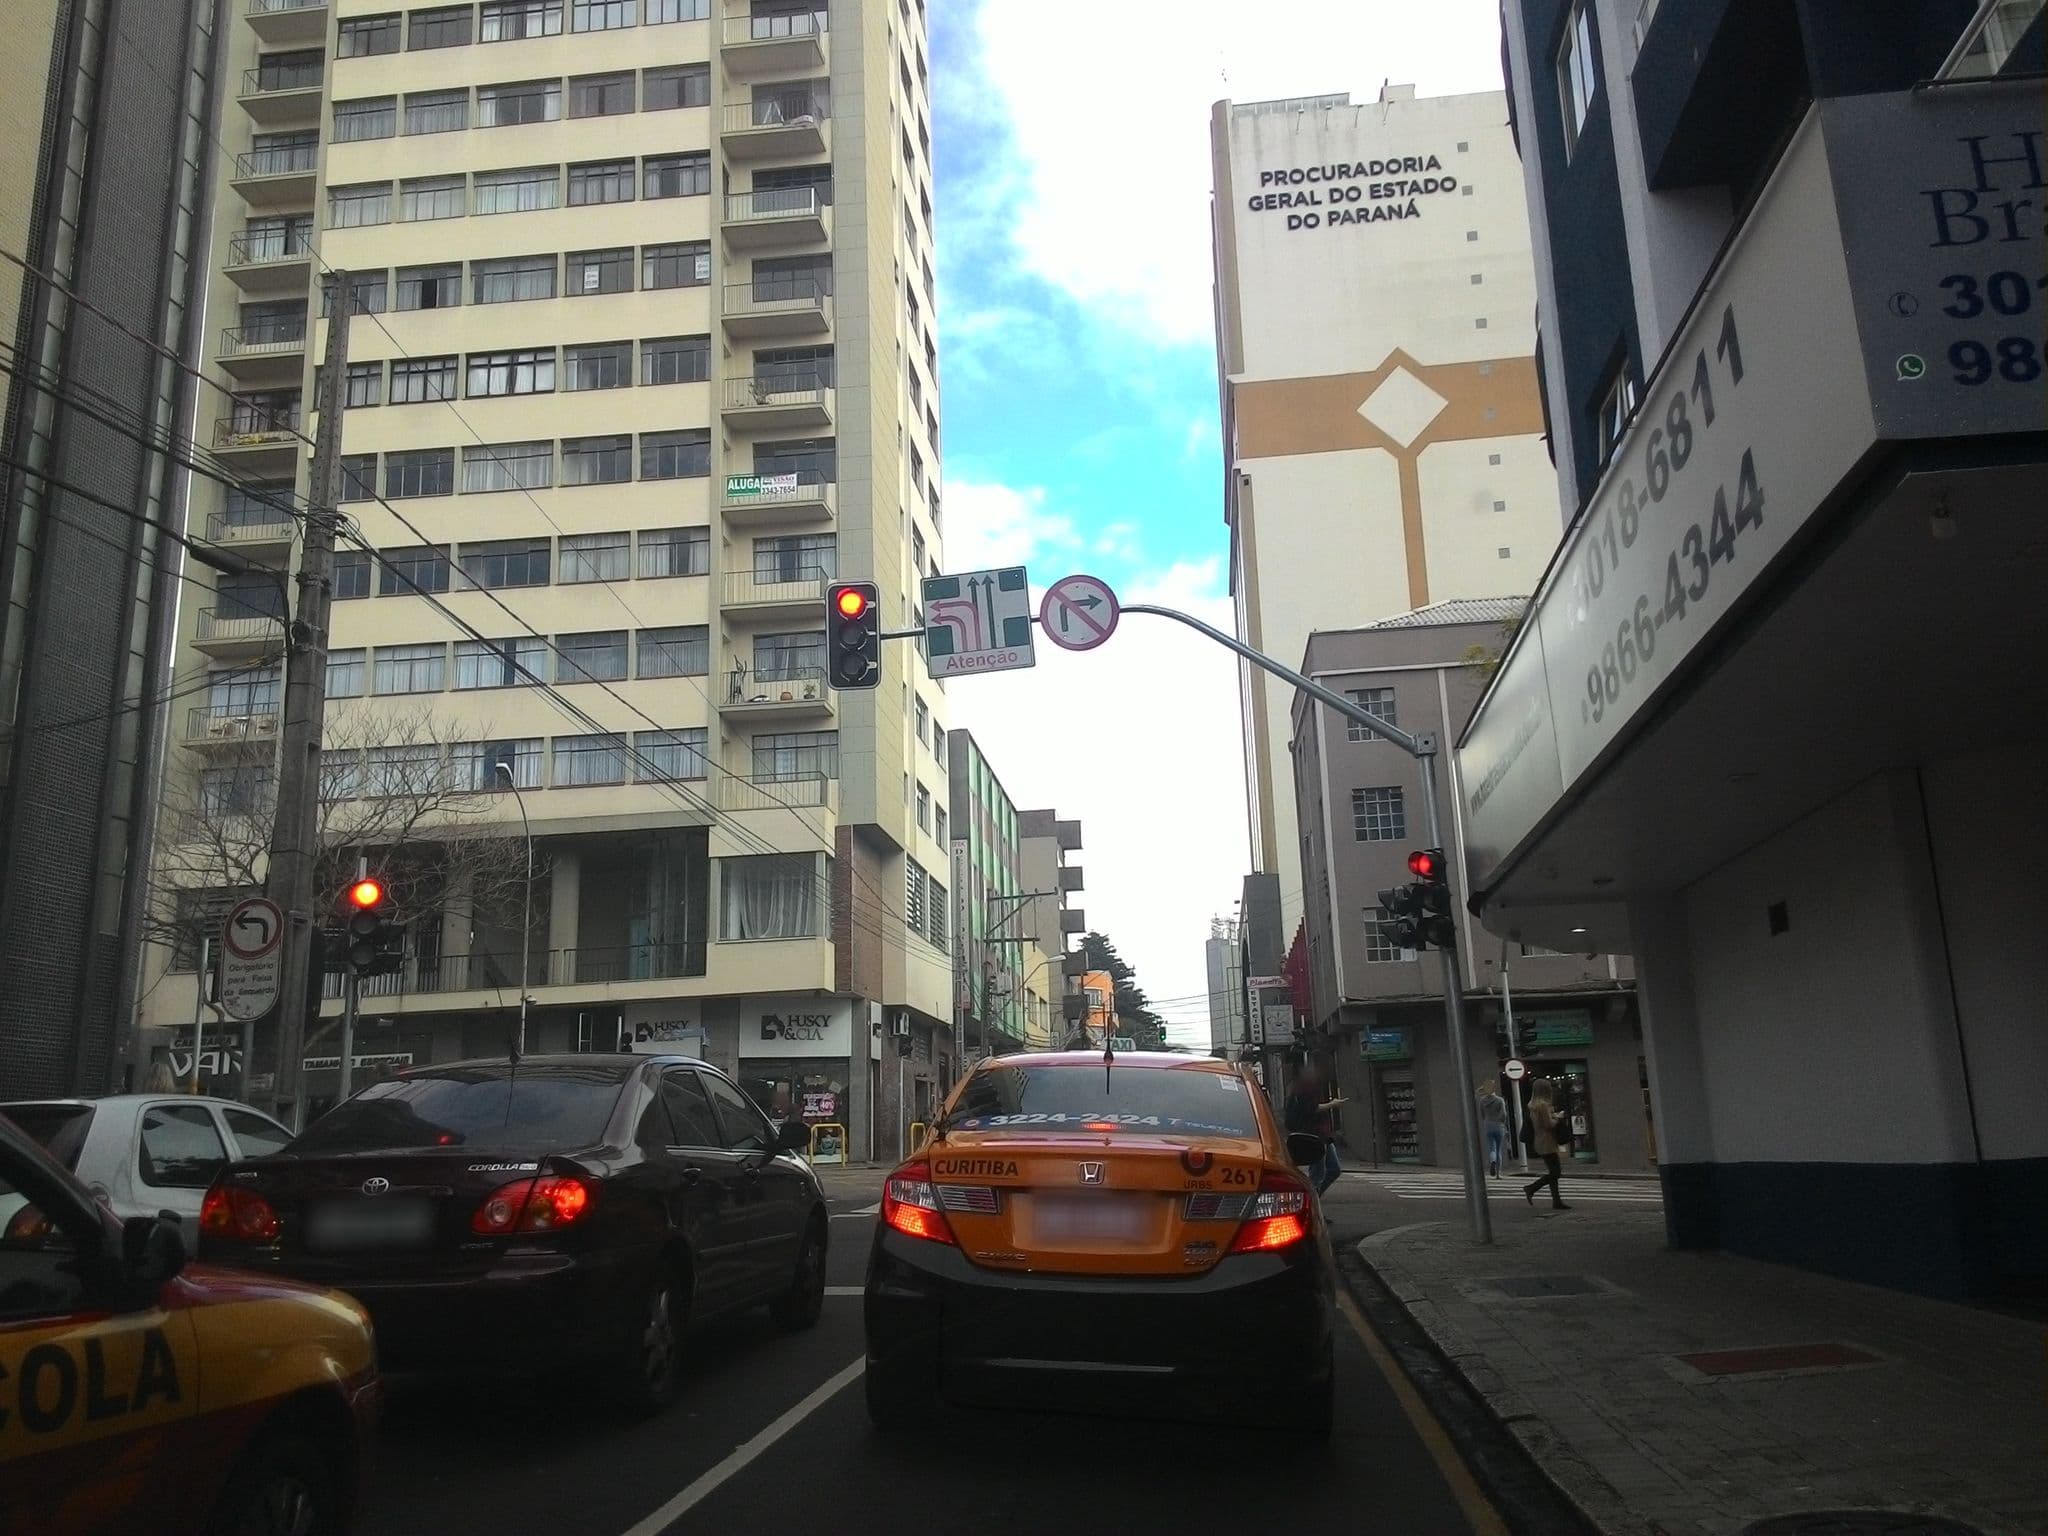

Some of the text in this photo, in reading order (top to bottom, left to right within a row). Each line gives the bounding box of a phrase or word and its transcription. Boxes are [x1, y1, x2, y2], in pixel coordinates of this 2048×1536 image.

[1260, 154, 1442, 188] PROCURADORIA
[1248, 175, 1458, 212] GERAL DO ESTADO
[1287, 198, 1420, 231] DO PARANÁ
[1919, 188, 2048, 248] Br
[1939, 270, 2048, 320] 30
[1947, 336, 2048, 386] 98
[727, 476, 761, 491] ALUGA
[945, 650, 1018, 672] Atenção
[653, 1019, 689, 1032] HUSKY
[788, 1014, 832, 1028] HUSKY
[784, 1027, 824, 1042] &CIA
[989, 1111, 1161, 1127] 3224-2424
[467, 1163, 518, 1172] COROLLA
[934, 1159, 1019, 1177] CURITIBA
[1221, 1167, 1257, 1185] 261
[1183, 1180, 1213, 1190] URBS
[0, 1327, 182, 1434] OLA
